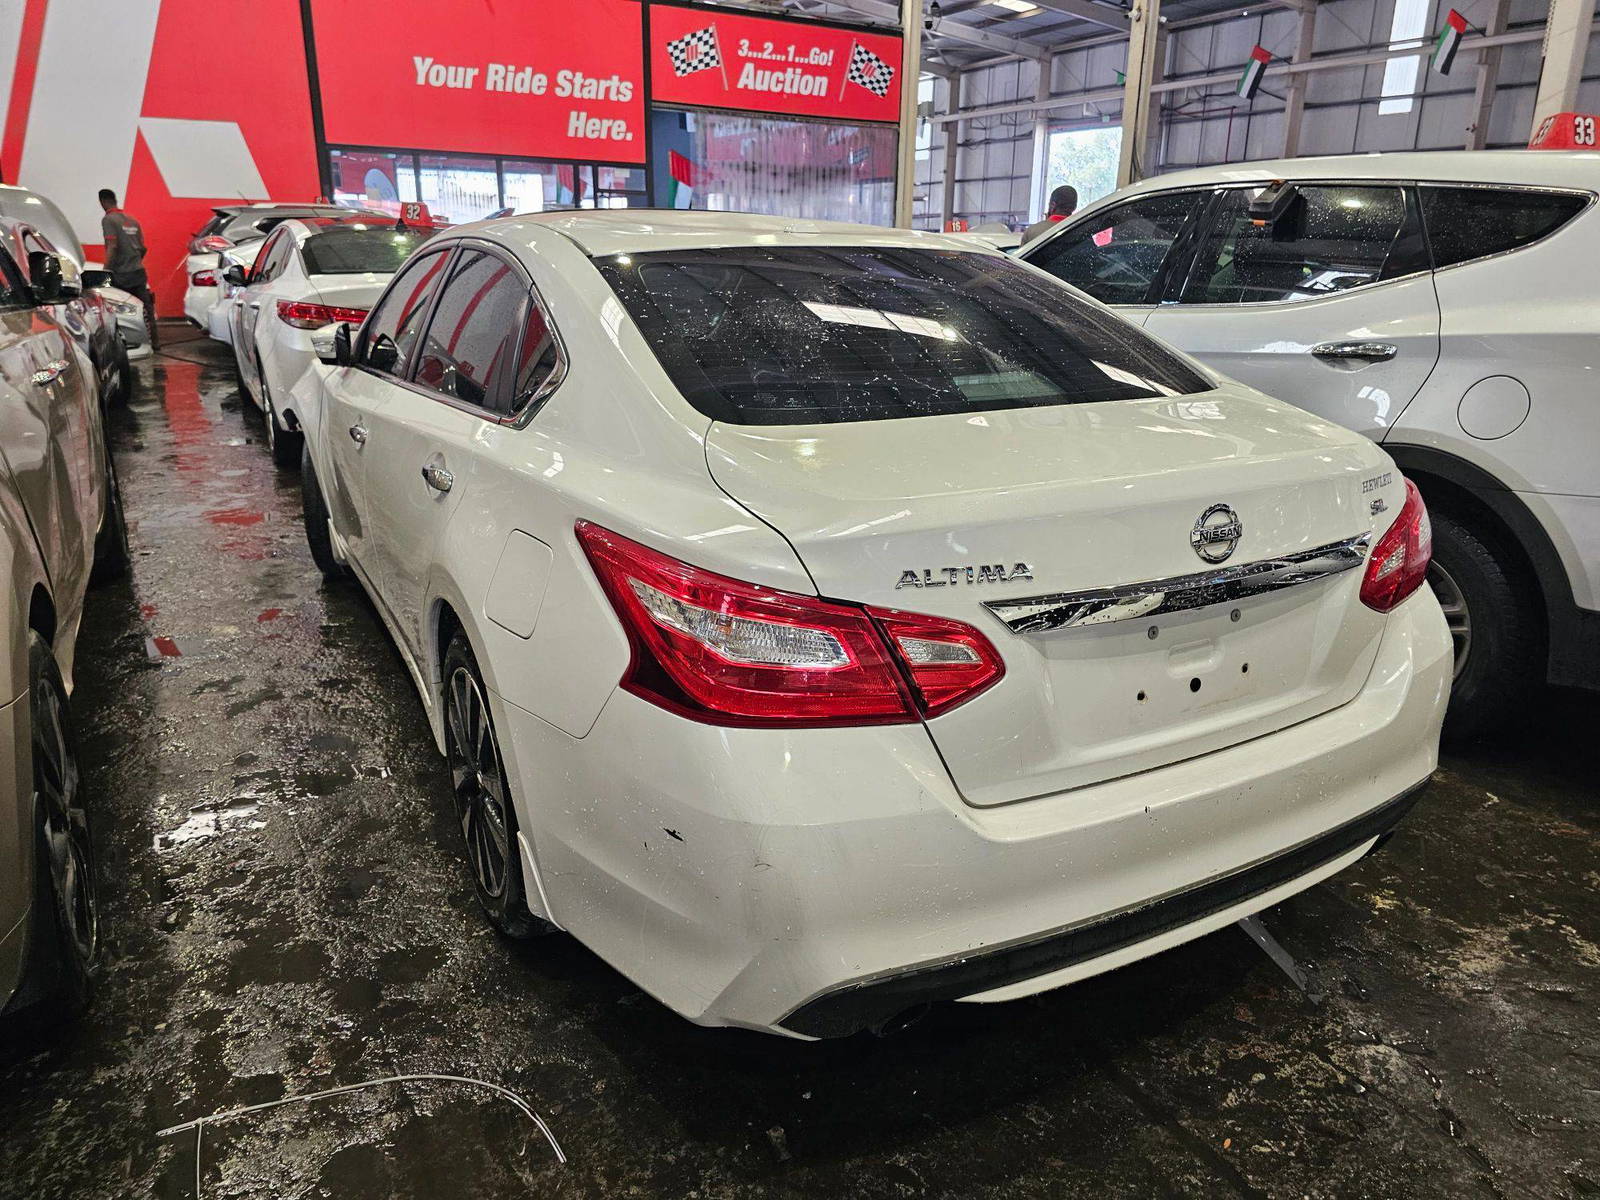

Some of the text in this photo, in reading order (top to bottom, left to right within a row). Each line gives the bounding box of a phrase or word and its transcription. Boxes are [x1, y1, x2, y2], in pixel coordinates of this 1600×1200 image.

[413, 56, 634, 102] Your Ride Starts
[737, 62, 829, 97] Auction
[567, 111, 633, 142] Here.
[1574, 116, 1595, 146] 33
[406, 203, 421, 220] 32
[1199, 525, 1240, 542] NISSAN
[895, 562, 1034, 590] ALTIMA
